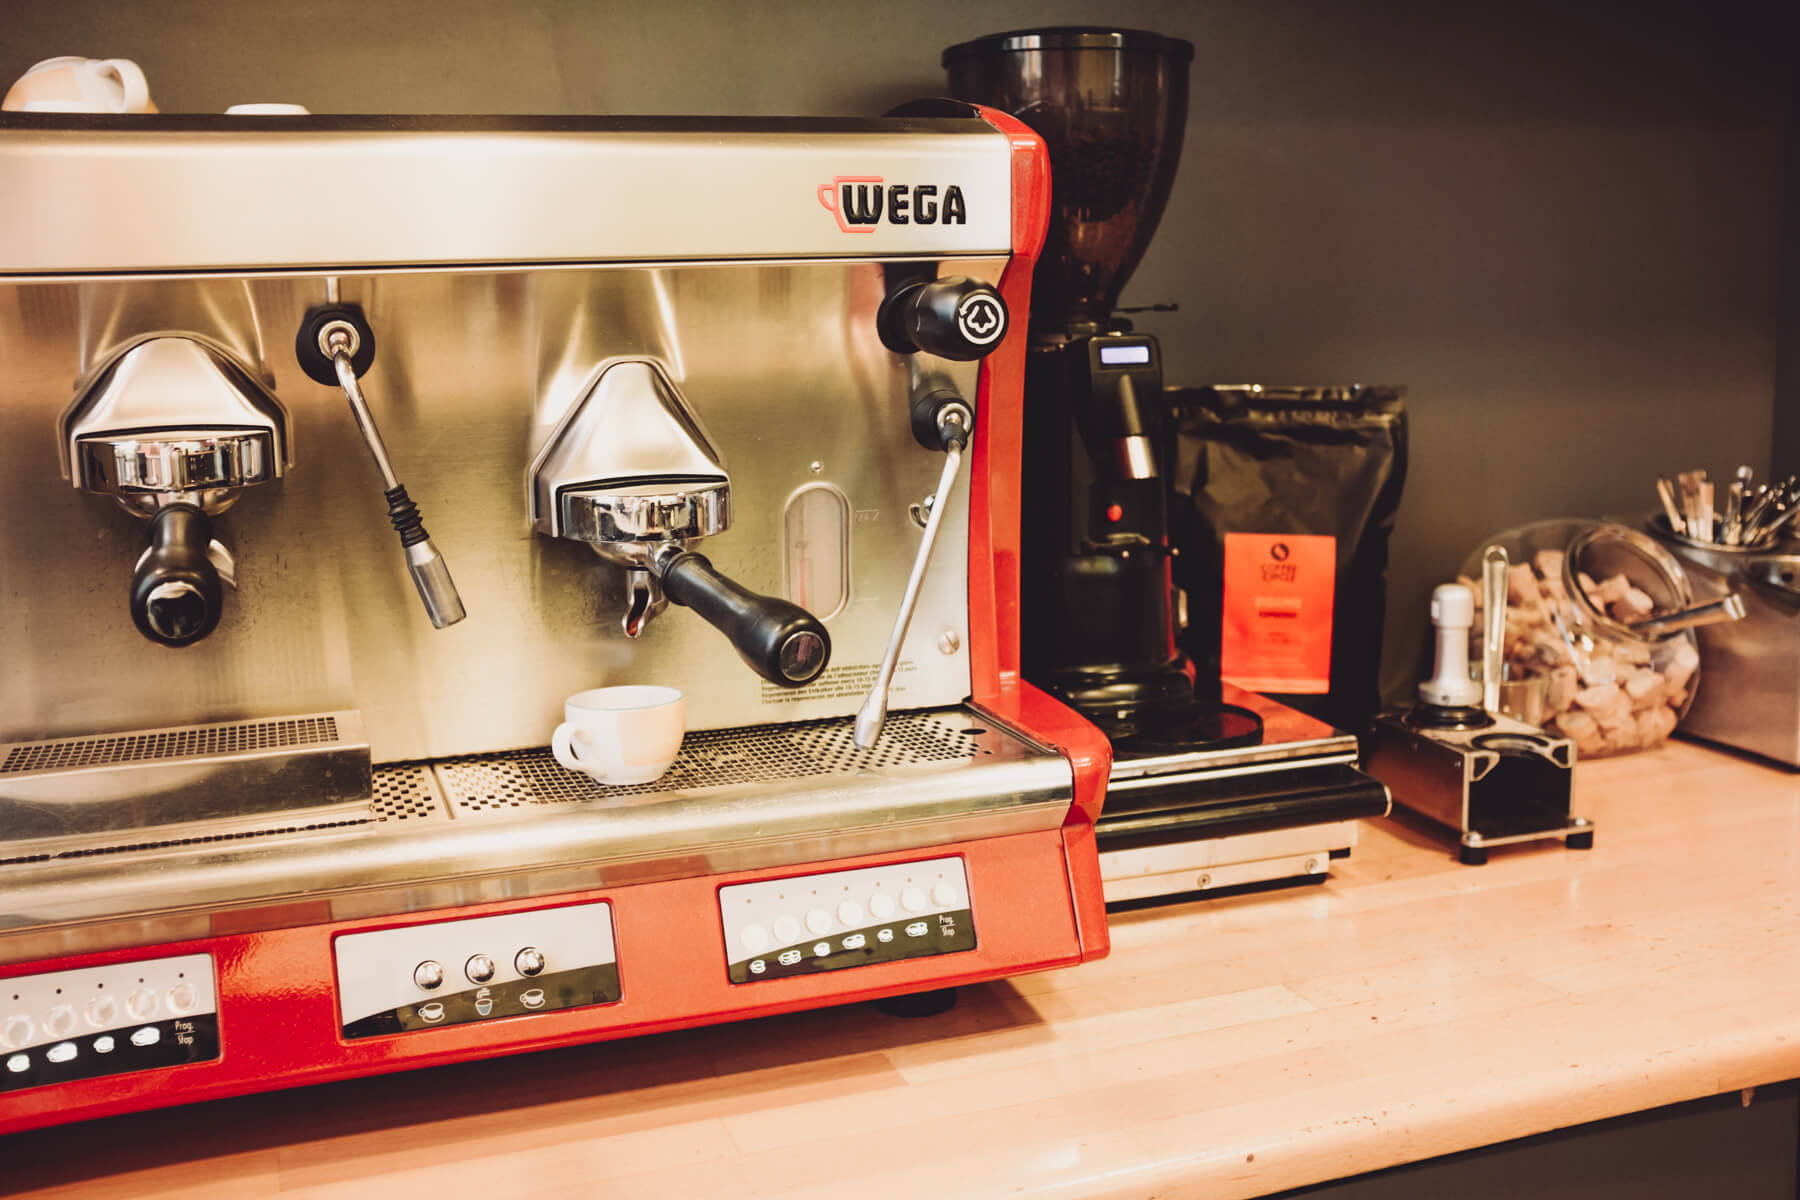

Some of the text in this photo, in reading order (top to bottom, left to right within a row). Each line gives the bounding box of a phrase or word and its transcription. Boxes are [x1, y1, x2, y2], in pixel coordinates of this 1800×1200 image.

[842, 184, 966, 225] WEGA
[175, 1021, 194, 1033] Prog.
[177, 1035, 193, 1046] Stop
